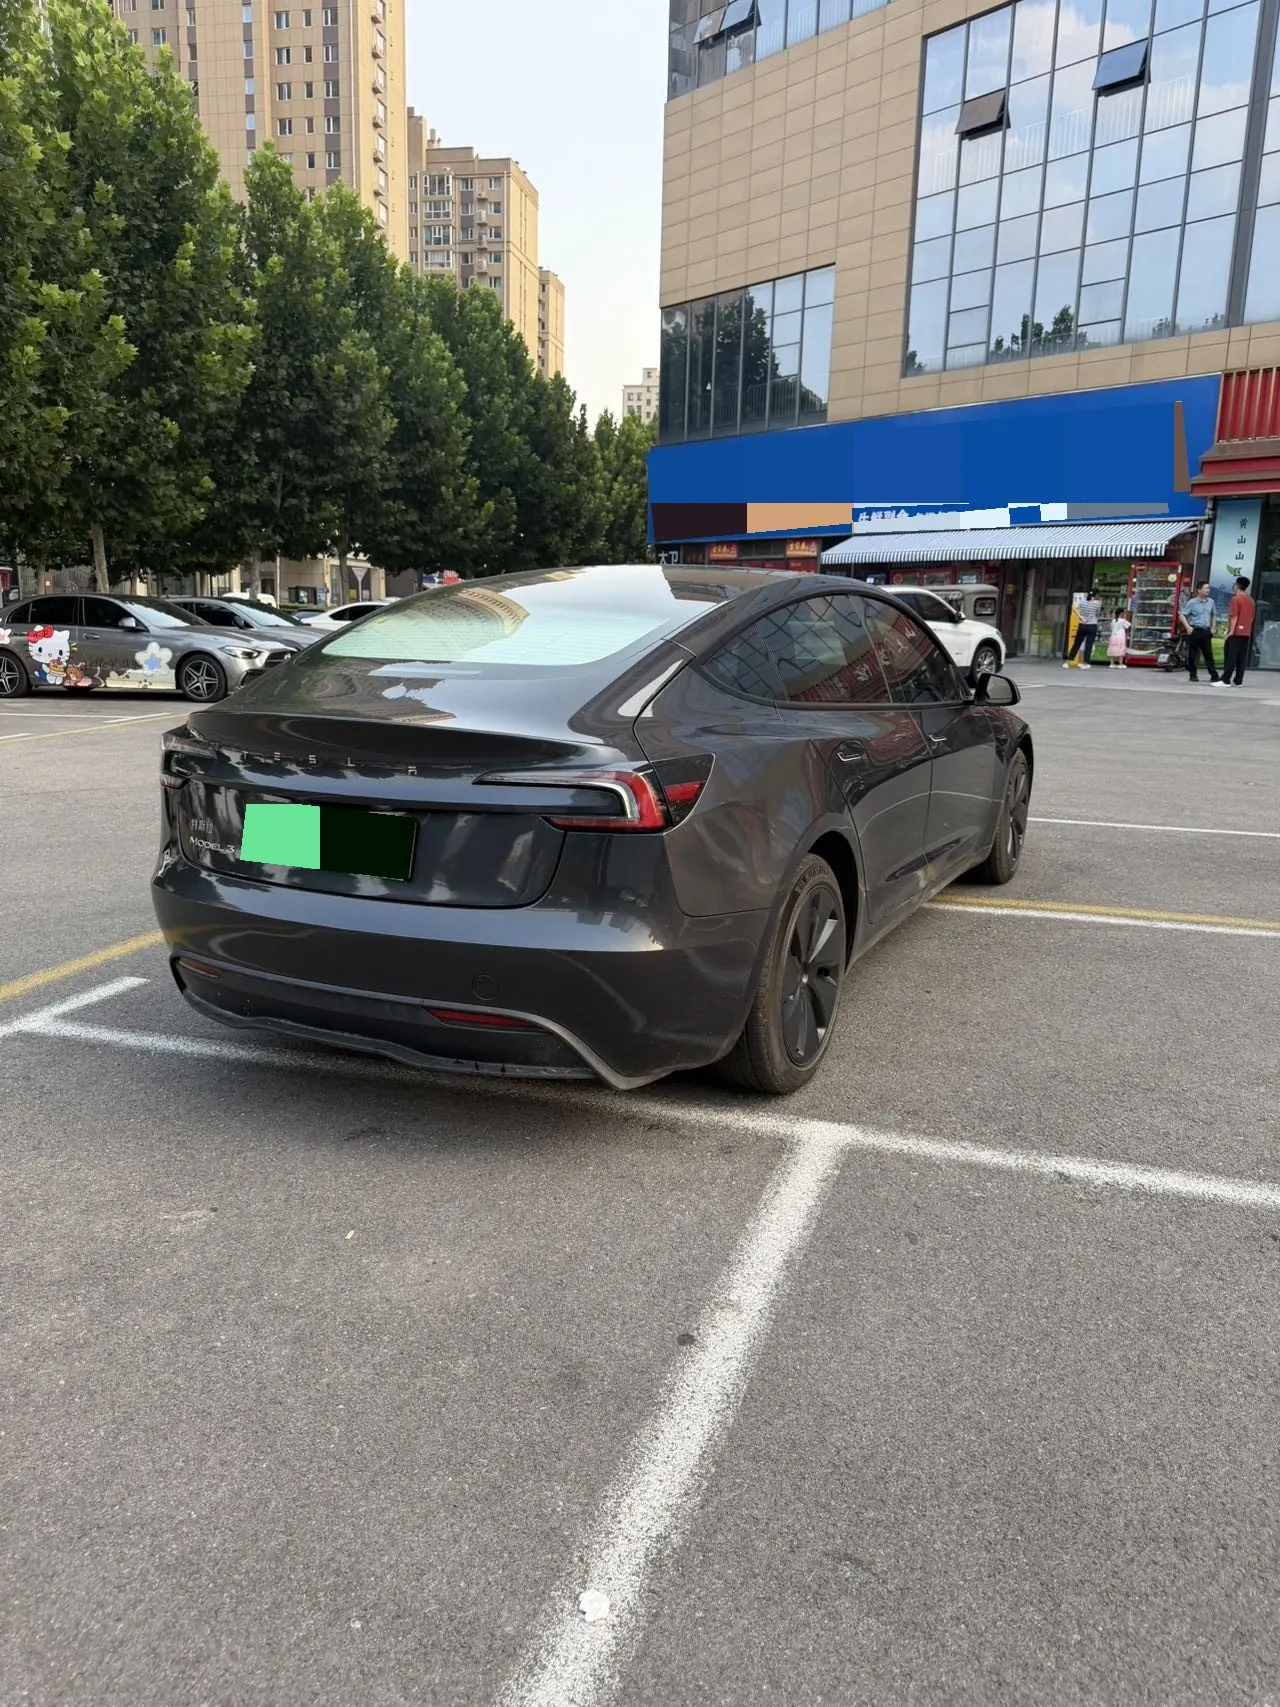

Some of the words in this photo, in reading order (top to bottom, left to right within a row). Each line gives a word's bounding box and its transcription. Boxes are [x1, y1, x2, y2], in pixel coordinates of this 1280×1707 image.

[242, 750, 418, 776] TESLA
[190, 836, 224, 852] MODEL
[227, 844, 236, 854] 3
